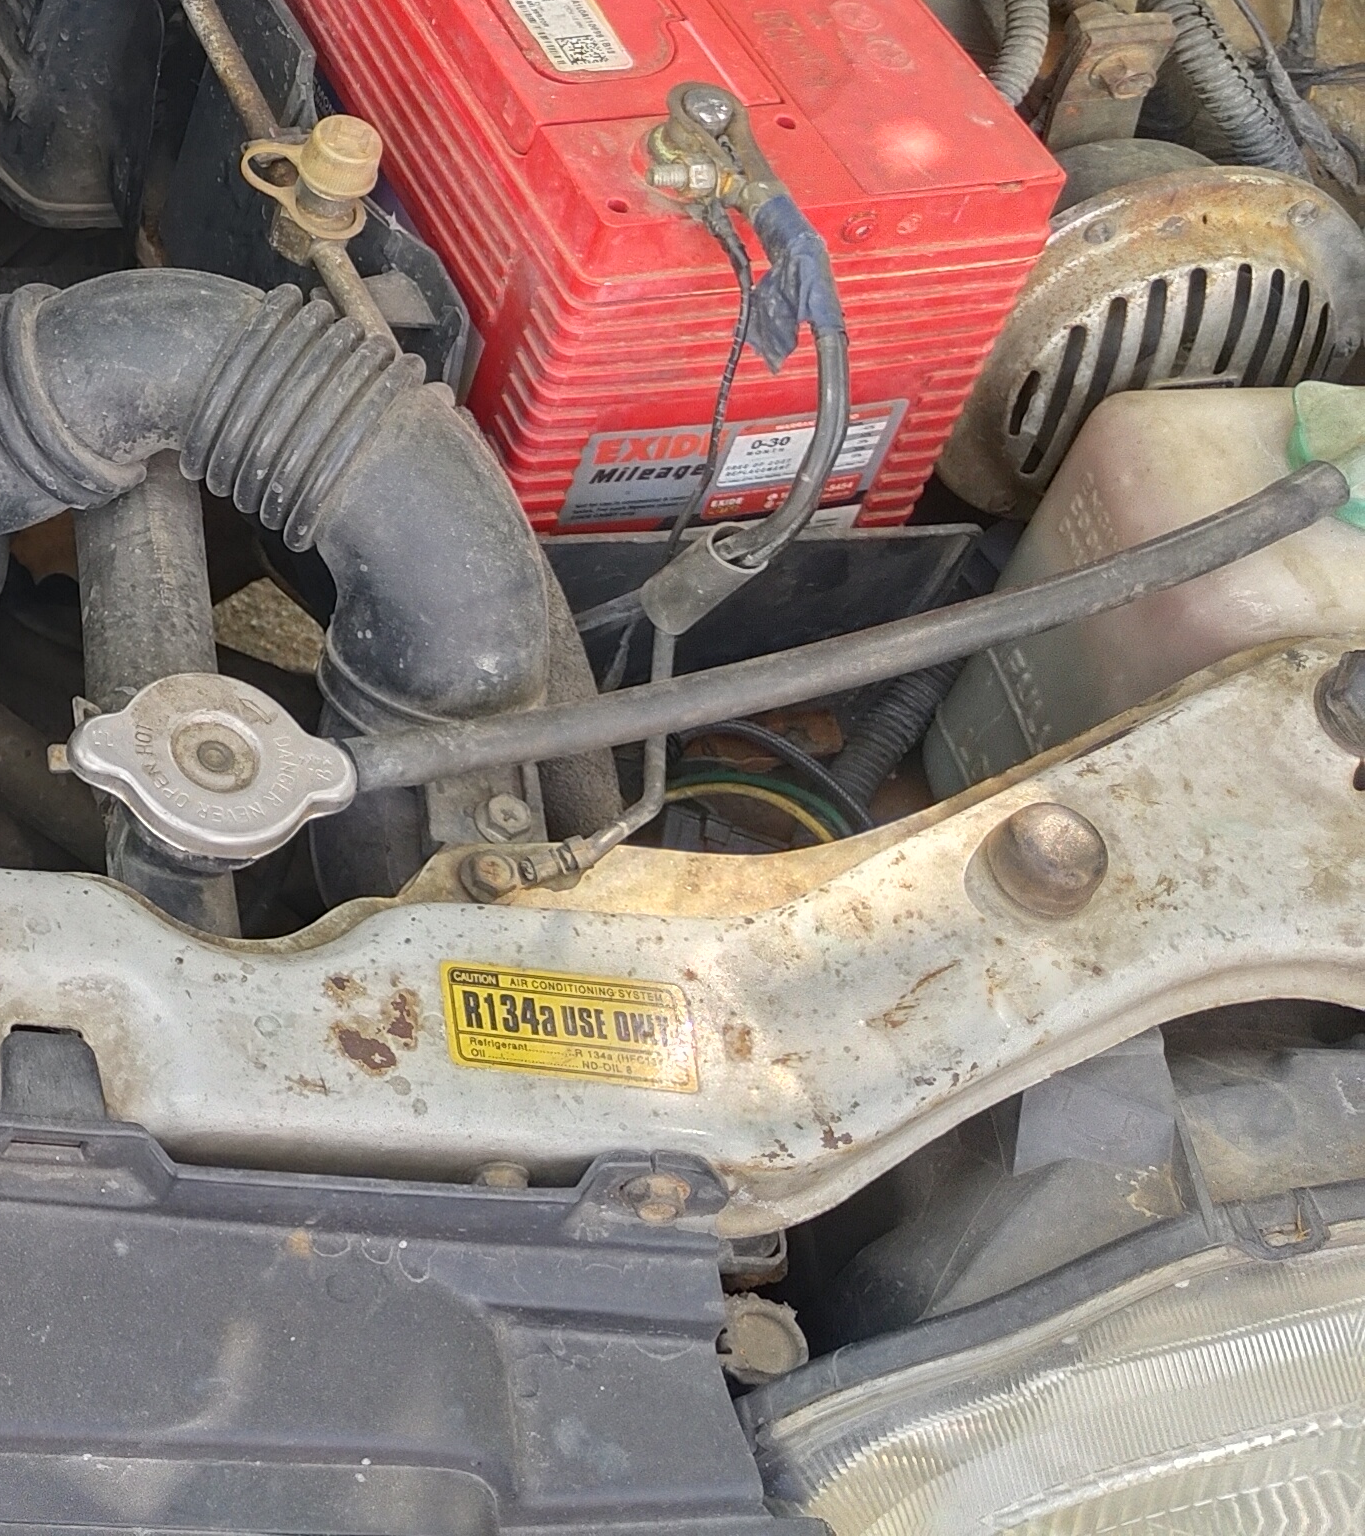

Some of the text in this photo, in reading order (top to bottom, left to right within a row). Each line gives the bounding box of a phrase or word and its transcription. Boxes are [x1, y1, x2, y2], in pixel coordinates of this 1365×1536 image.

[592, 429, 731, 465] EXIDE
[750, 435, 792, 450] 0-30
[588, 462, 705, 486] Mileage
[133, 723, 155, 756] HOT
[141, 761, 191, 810] OPEN
[263, 735, 295, 812] DANGER
[197, 799, 266, 824] NEVER
[452, 970, 664, 1002] CAUTION AIR CONDITIONING SYSTEM
[461, 989, 559, 1038] R134a
[559, 1005, 609, 1040] USE
[468, 1036, 529, 1052] Refrigerant
[587, 1050, 614, 1061] 134a
